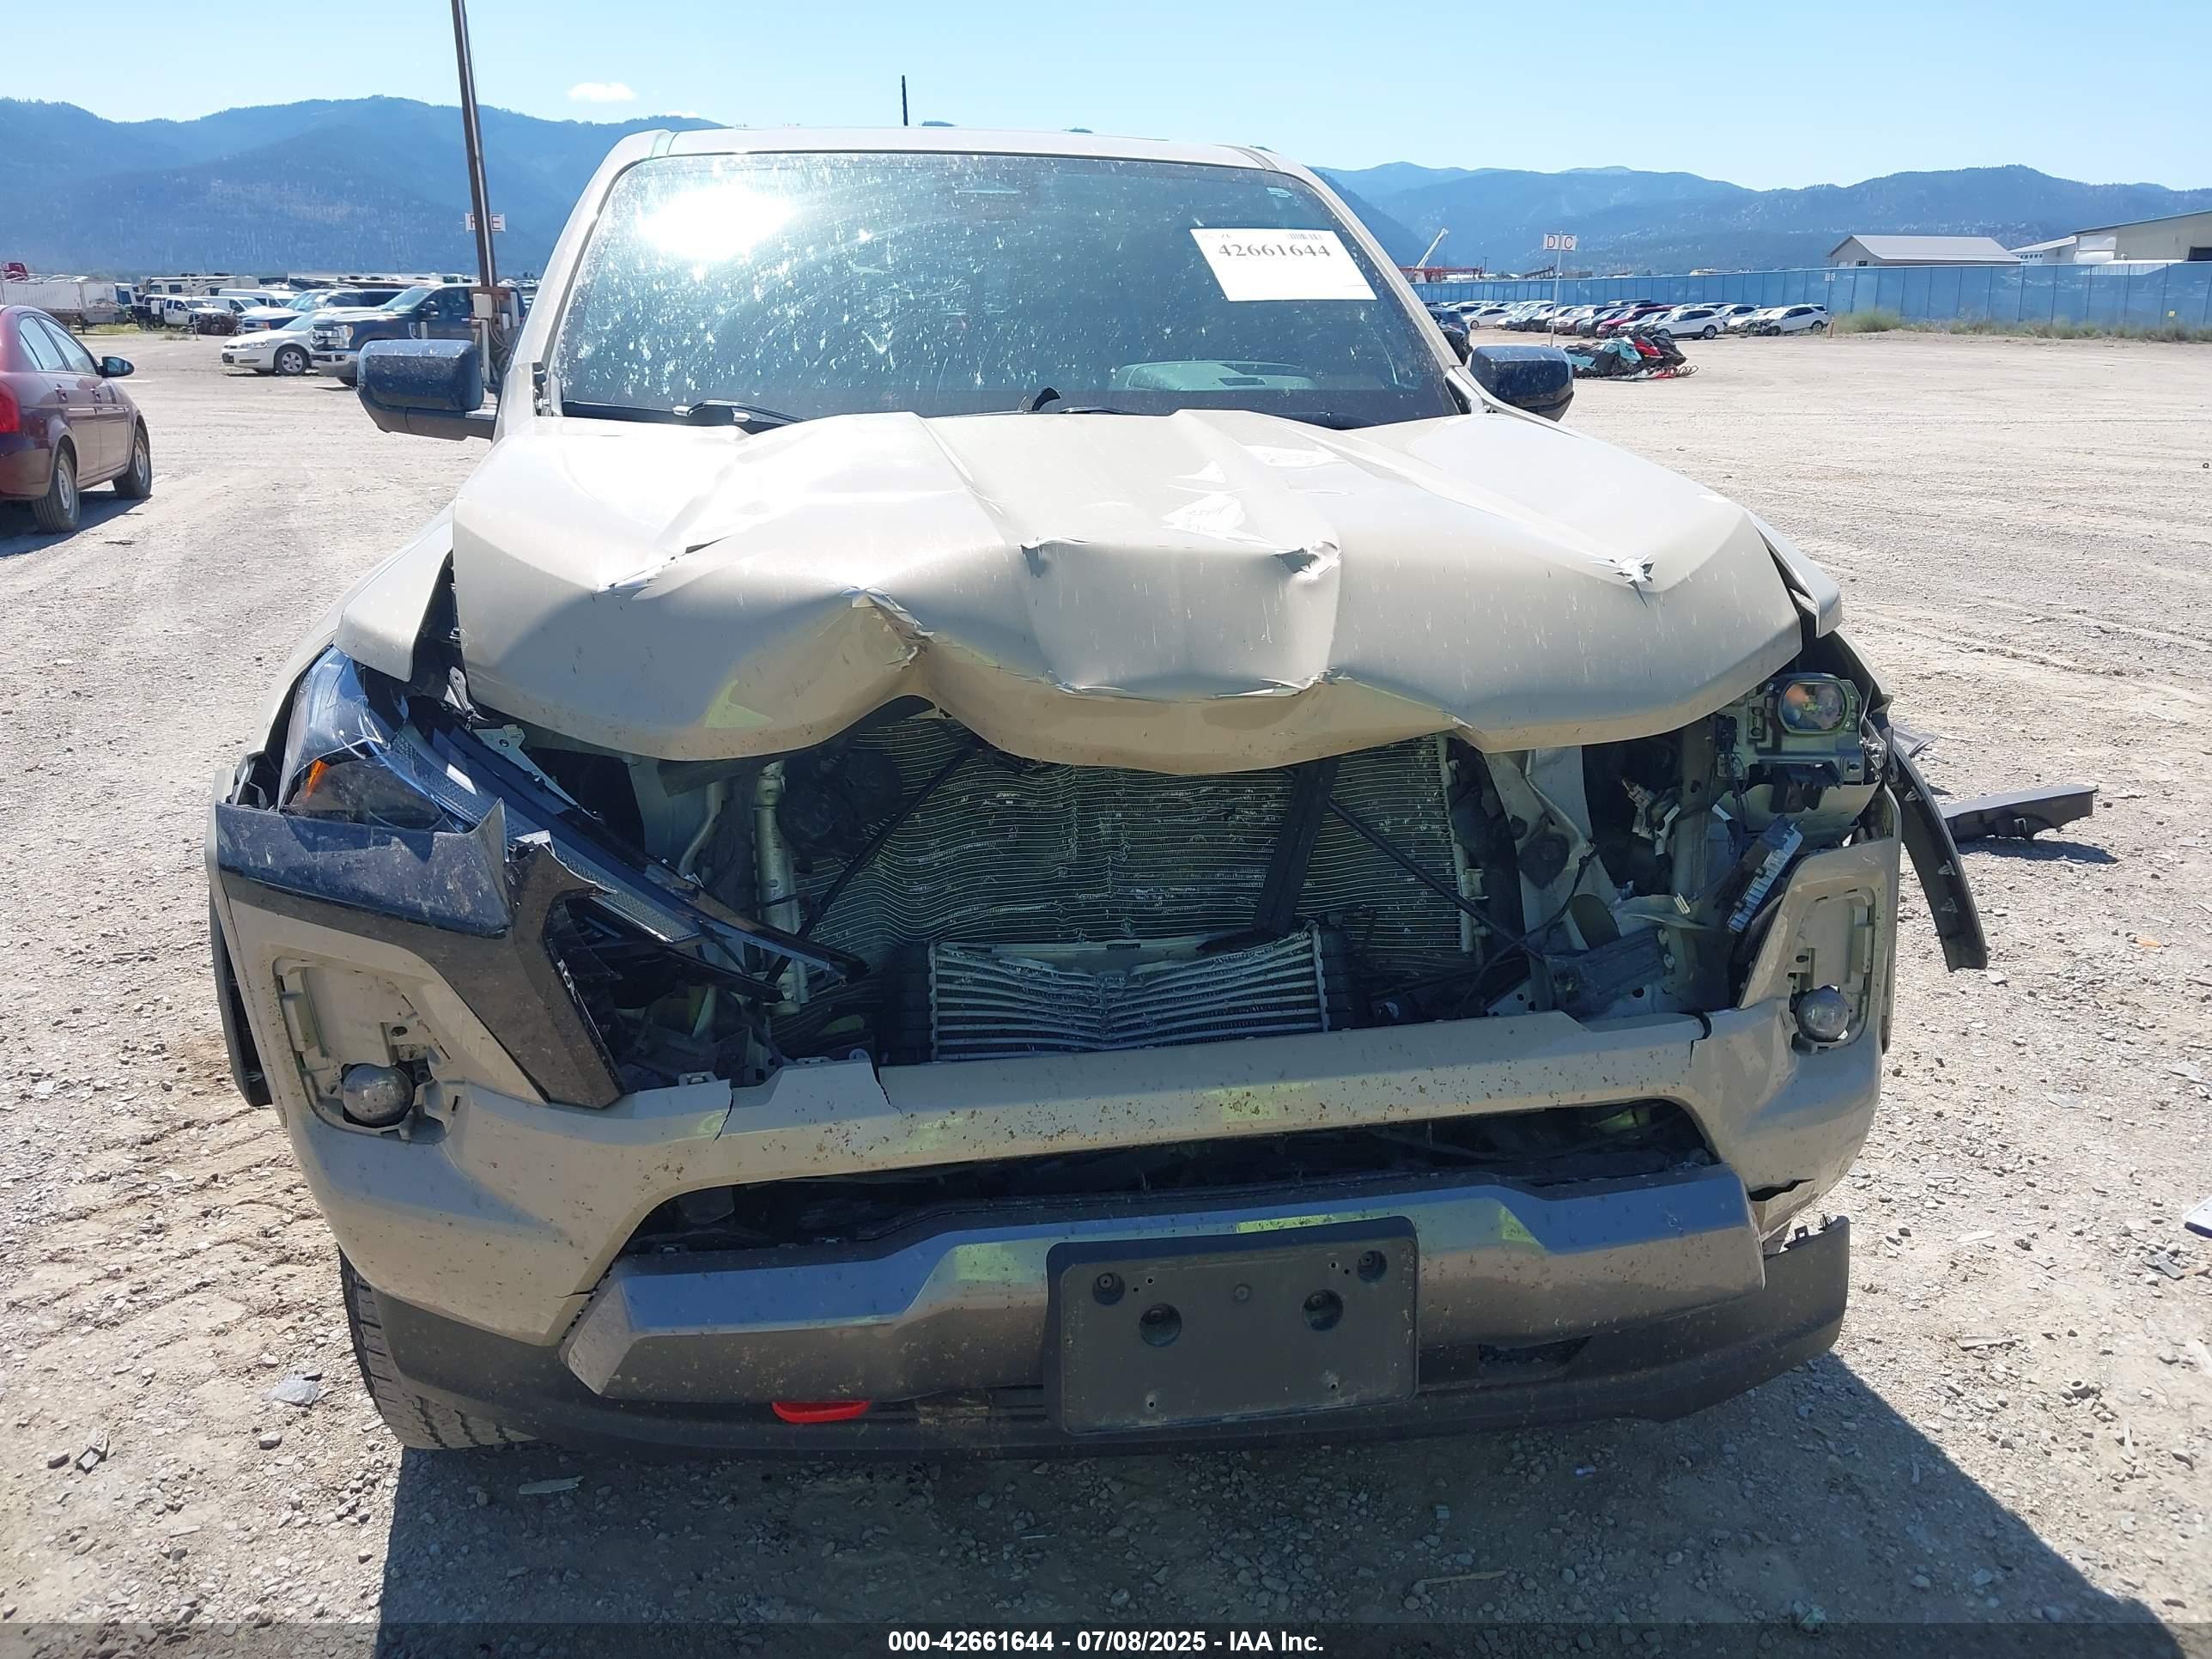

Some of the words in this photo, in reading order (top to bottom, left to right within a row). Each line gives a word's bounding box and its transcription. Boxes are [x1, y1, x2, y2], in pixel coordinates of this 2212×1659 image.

[1547, 235, 1555, 248] D
[1564, 236, 1573, 249] C
[1218, 244, 1330, 257] 42661644
